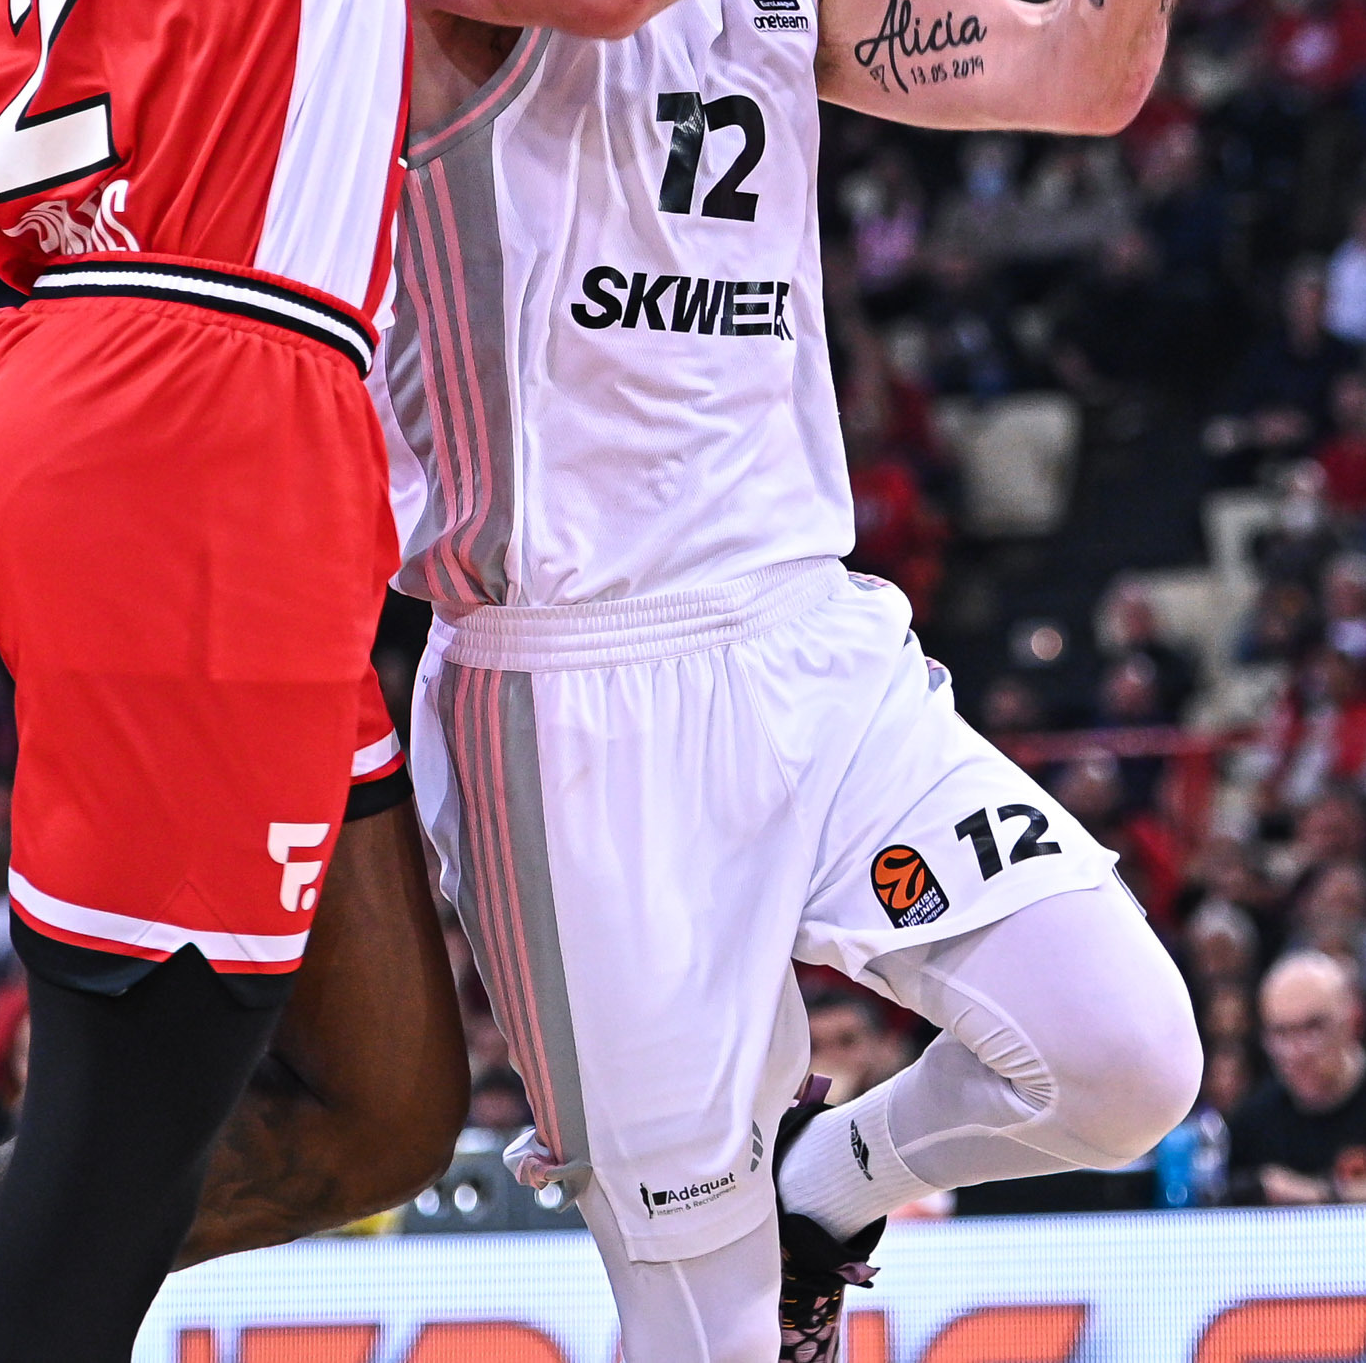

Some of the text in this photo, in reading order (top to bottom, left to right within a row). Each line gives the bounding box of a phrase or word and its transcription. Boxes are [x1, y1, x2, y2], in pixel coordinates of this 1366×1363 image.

[753, 13, 809, 30] oneteam
[910, 55, 985, 85] 13.05.2019
[655, 91, 766, 223] 12
[953, 803, 1063, 882] 12
[898, 886, 937, 926] TURKISH
[906, 894, 941, 927] IRLINES
[667, 1172, 735, 1204] Adéquat
